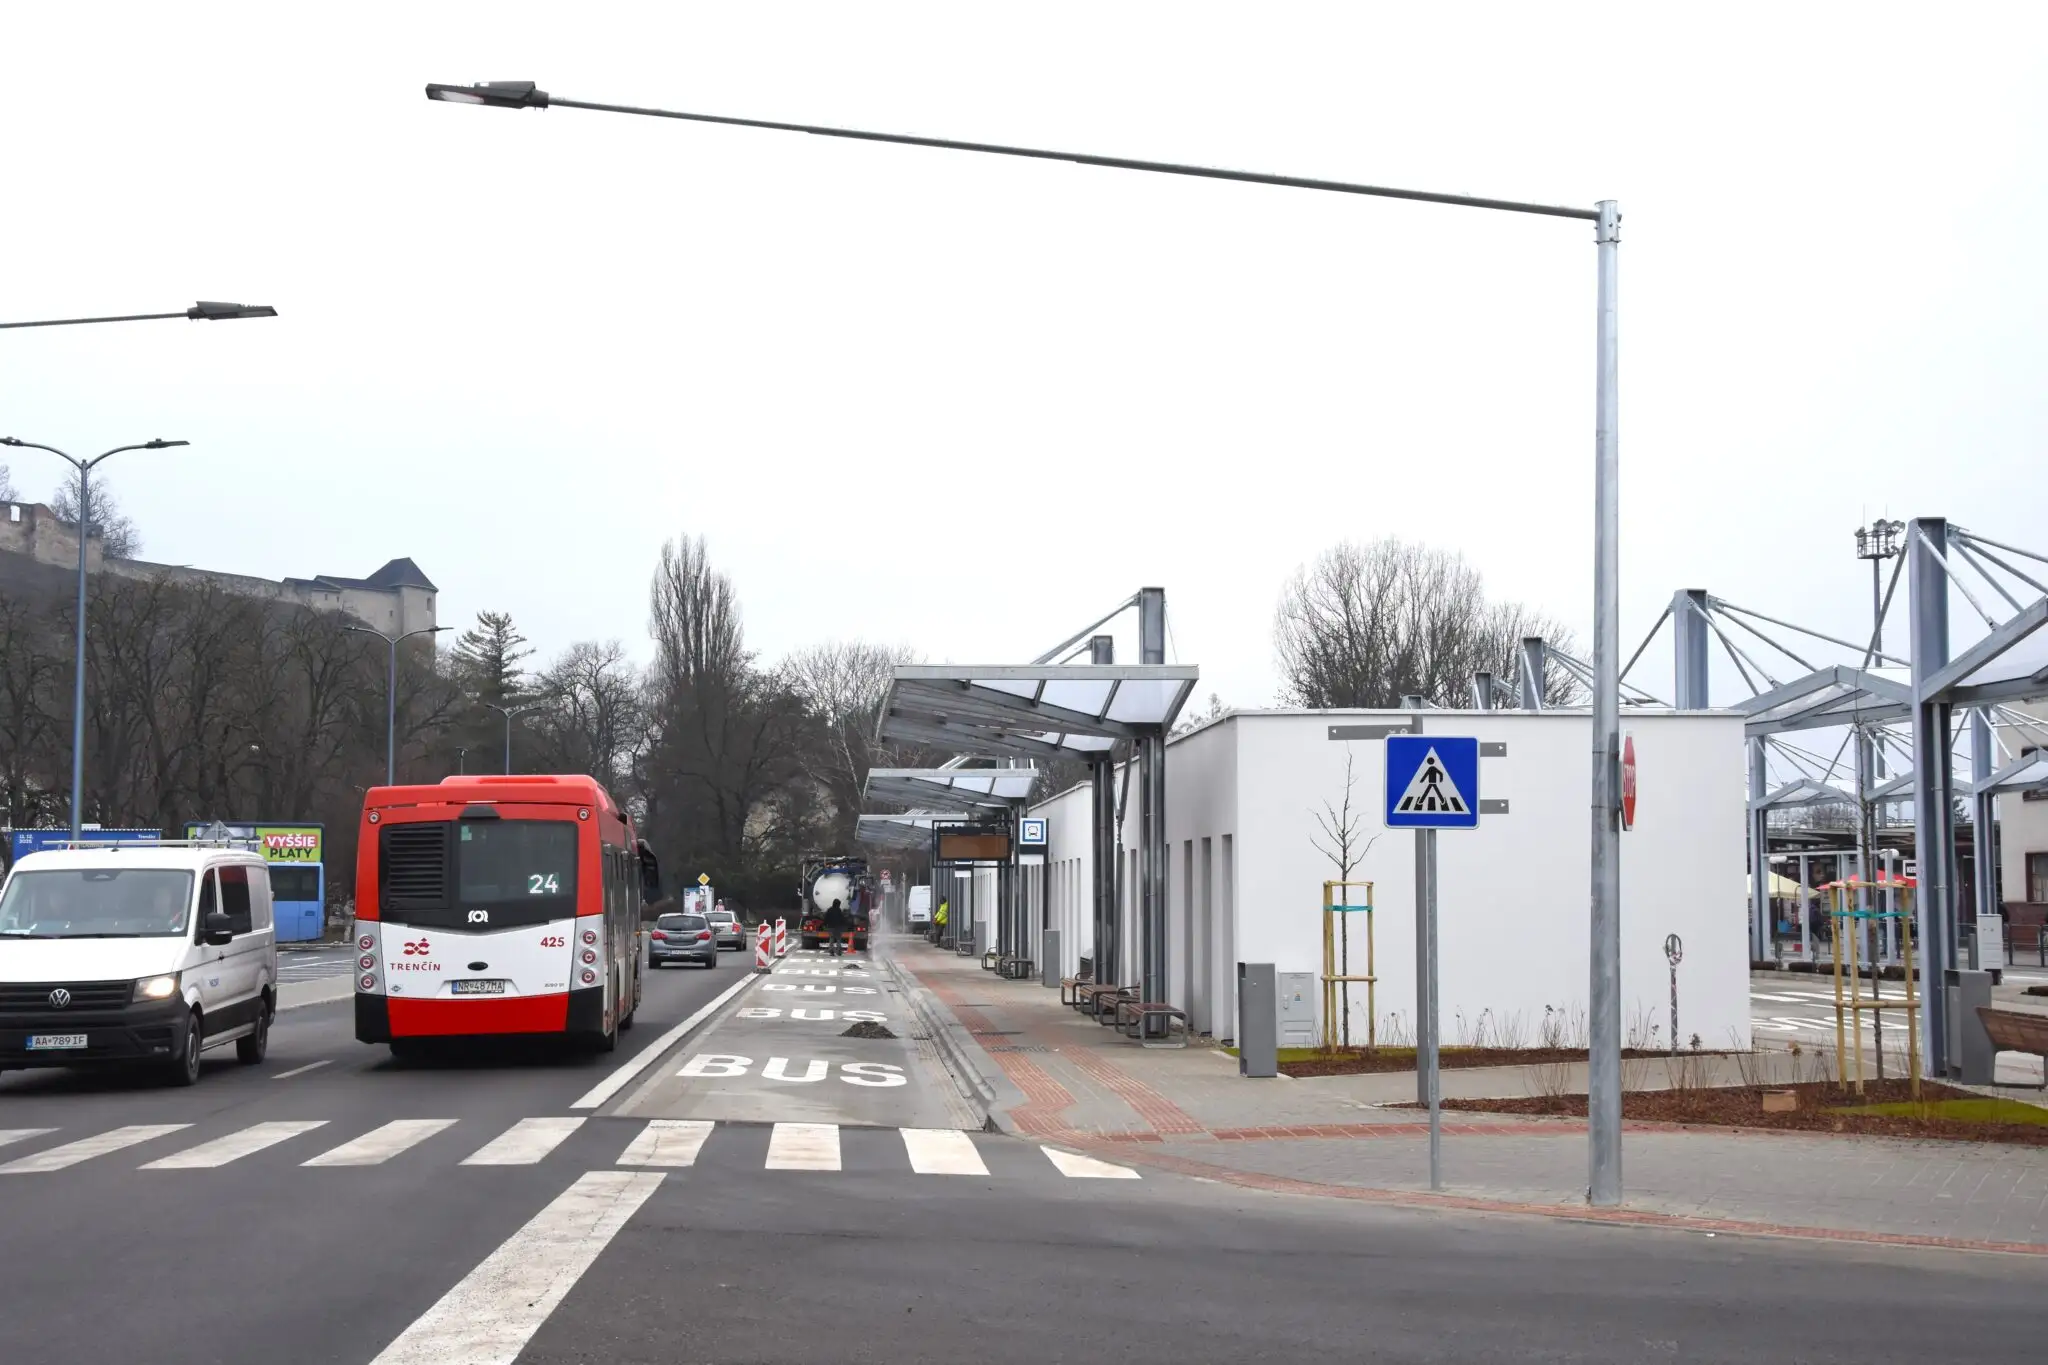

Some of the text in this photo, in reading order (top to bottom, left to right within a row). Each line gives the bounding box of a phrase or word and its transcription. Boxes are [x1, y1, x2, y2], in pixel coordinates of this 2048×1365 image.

[1623, 764, 1636, 797] STOP
[266, 833, 316, 847] VYŠŠIE
[270, 848, 313, 858] PLATY
[529, 874, 558, 894] 24
[540, 937, 565, 947] 425
[390, 962, 441, 971] TRENČÍN
[761, 984, 877, 995] BUS
[735, 1008, 888, 1022] BUS
[675, 1054, 908, 1087] BUS
